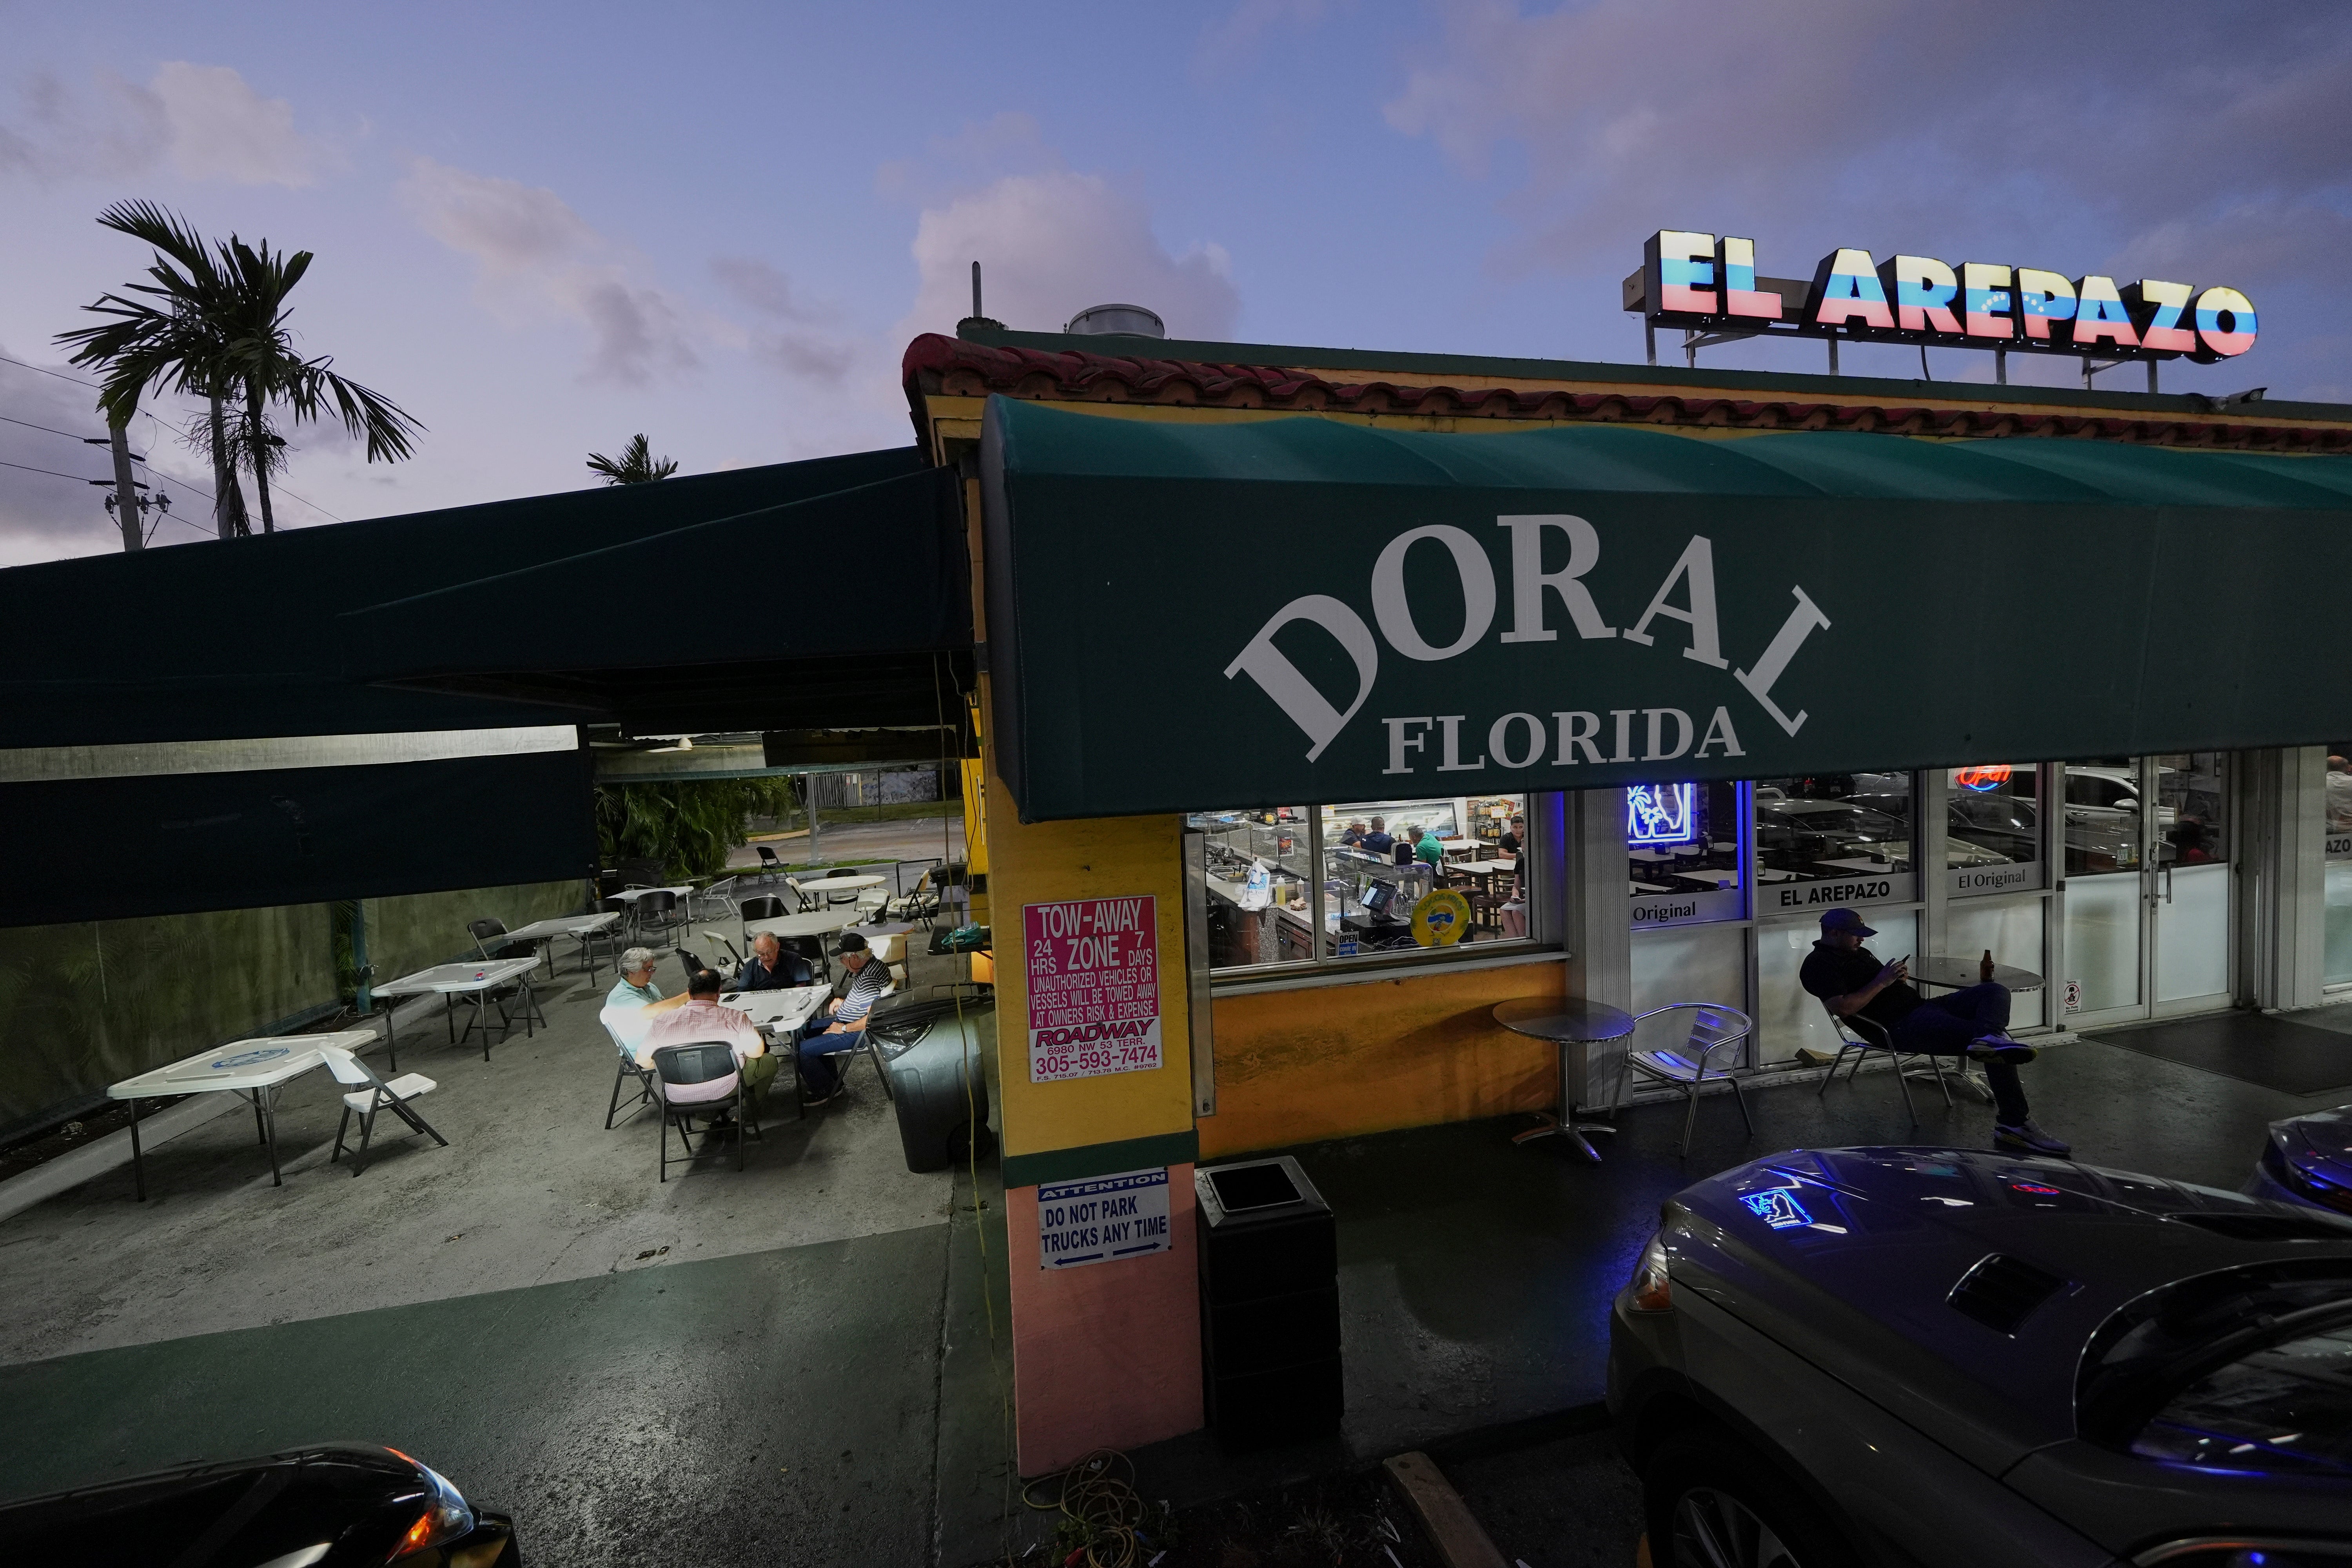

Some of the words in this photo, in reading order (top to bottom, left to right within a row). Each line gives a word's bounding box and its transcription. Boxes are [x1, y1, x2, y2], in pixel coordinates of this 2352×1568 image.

[1660, 230, 1782, 319] EL
[1816, 248, 2258, 358] AREPAZO
[1223, 513, 1831, 764] DORAL
[1381, 705, 1746, 775] FLORIDA
[1959, 874, 1970, 888] El
[1974, 869, 2025, 888] Original
[1780, 889, 1802, 906] EL
[1808, 881, 1890, 904] AREPAZO
[1038, 899, 1142, 938] TOW-AWAY
[1633, 901, 1695, 922] Original
[1034, 939, 1053, 957] 24
[1135, 931, 1145, 947] 7
[1339, 934, 1358, 944] OPEN
[1031, 957, 1057, 976] HRS
[1067, 935, 1120, 971] ZONE
[1128, 948, 1153, 967] DAYS
[1033, 971, 1096, 993] UNAUTHORIZED
[1098, 967, 1137, 987] VEHICLES
[1140, 966, 1152, 983] OR
[1030, 991, 1067, 1010] VESSELS
[1070, 989, 1090, 1006] WILL
[1092, 988, 1103, 1004] BE
[1105, 985, 1134, 1003] TOWED
[1137, 982, 1156, 1000] AWAY
[1036, 1011, 1045, 1028] AT
[1048, 1007, 1084, 1027] OWNERS
[1087, 1005, 1106, 1022] RISK
[1109, 1004, 1114, 1020] &
[1118, 1000, 1154, 1019] EXPENSE
[1035, 1018, 1156, 1048] ROADWAY
[1047, 1045, 1074, 1056] 6980
[1079, 1043, 1096, 1052] NW
[1100, 1041, 1113, 1049] 53
[1117, 1037, 1145, 1047] TERR.
[1036, 1045, 1157, 1075] 305-593-7474
[1041, 1173, 1166, 1199] ATTENTION
[1046, 1207, 1065, 1228] DO
[1069, 1202, 1097, 1225] NOT
[1102, 1196, 1138, 1219] PARK
[1042, 1227, 1098, 1253] TRUCKS
[1103, 1221, 1130, 1244] ANY
[1134, 1215, 1167, 1238] TIME
